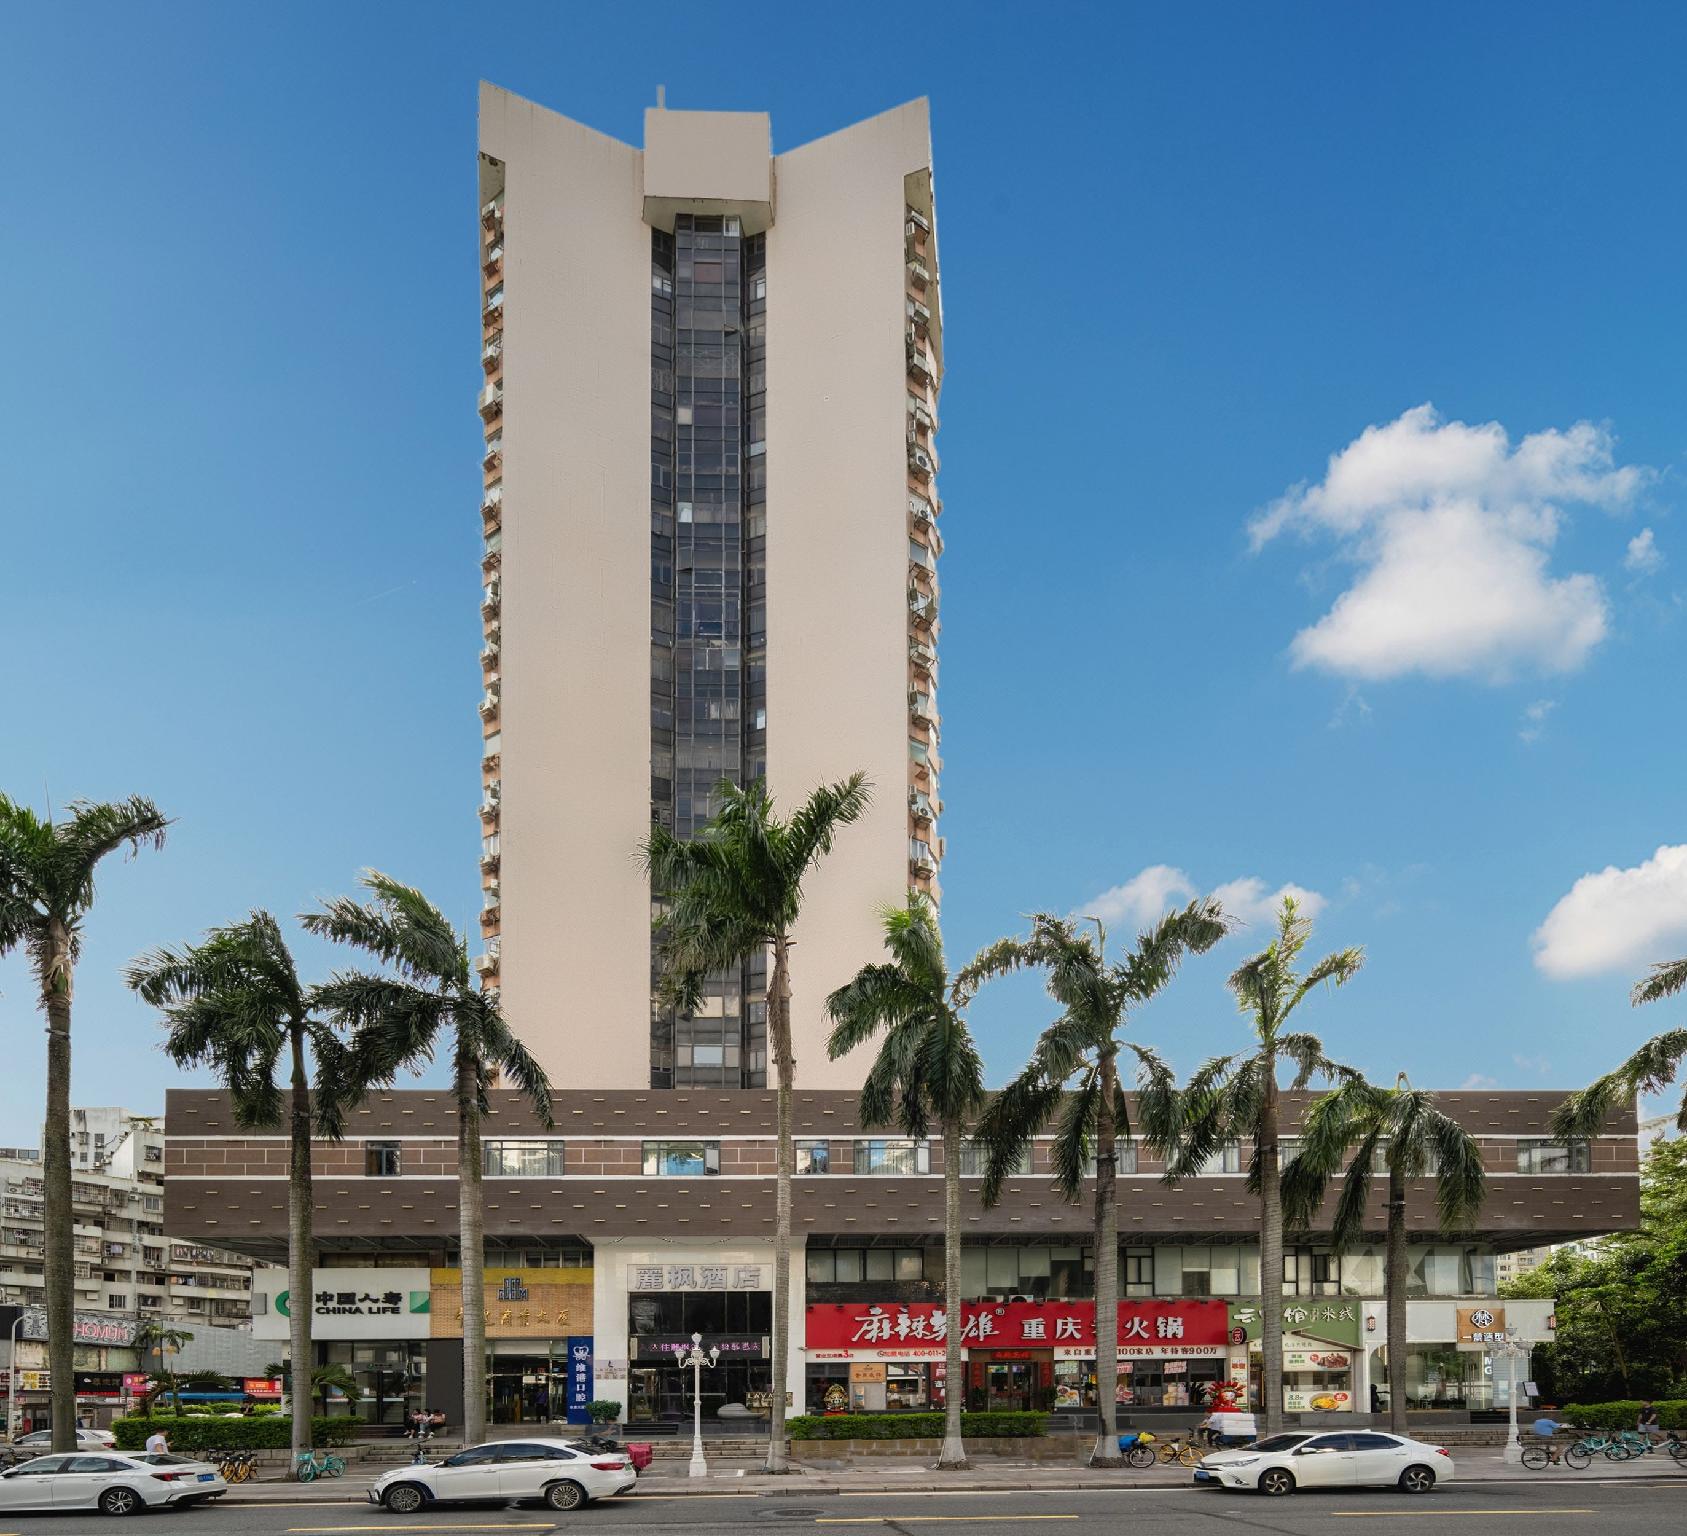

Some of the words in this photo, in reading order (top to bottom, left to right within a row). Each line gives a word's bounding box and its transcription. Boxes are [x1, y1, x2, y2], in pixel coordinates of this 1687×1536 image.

[315, 1291, 403, 1306] 中国人寿
[315, 1306, 364, 1315] CHINA
[368, 1306, 401, 1315] LIFE
[1233, 1307, 1308, 1324] 云馆
[1321, 1307, 1356, 1322] 米线
[1020, 1317, 1184, 1340] 重庆火锅
